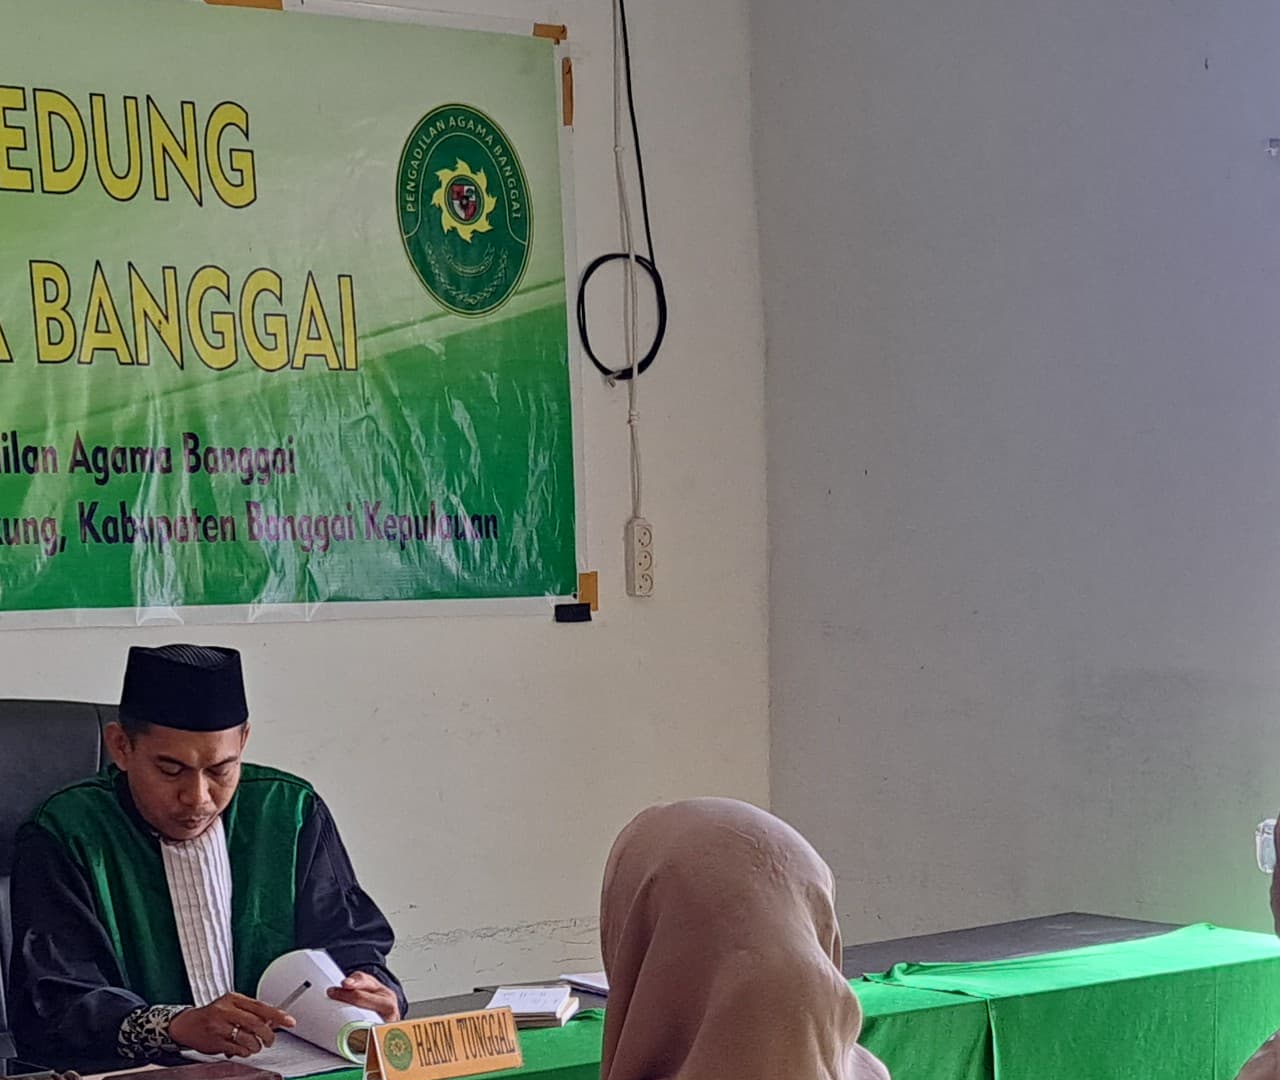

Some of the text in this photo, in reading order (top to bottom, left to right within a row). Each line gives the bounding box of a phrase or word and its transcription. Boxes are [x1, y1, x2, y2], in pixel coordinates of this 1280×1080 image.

[406, 115, 521, 219] PENGADILAN AGAMA BANGGAI
[28, 258, 360, 373] BANGGAI
[68, 430, 174, 486] Agama
[181, 431, 297, 487] Banggai
[77, 500, 238, 555] Kabupaten
[245, 500, 355, 554] Banggai
[362, 500, 499, 553] Kepulauan
[412, 1011, 517, 1068] HAKIM TUNGGAL
